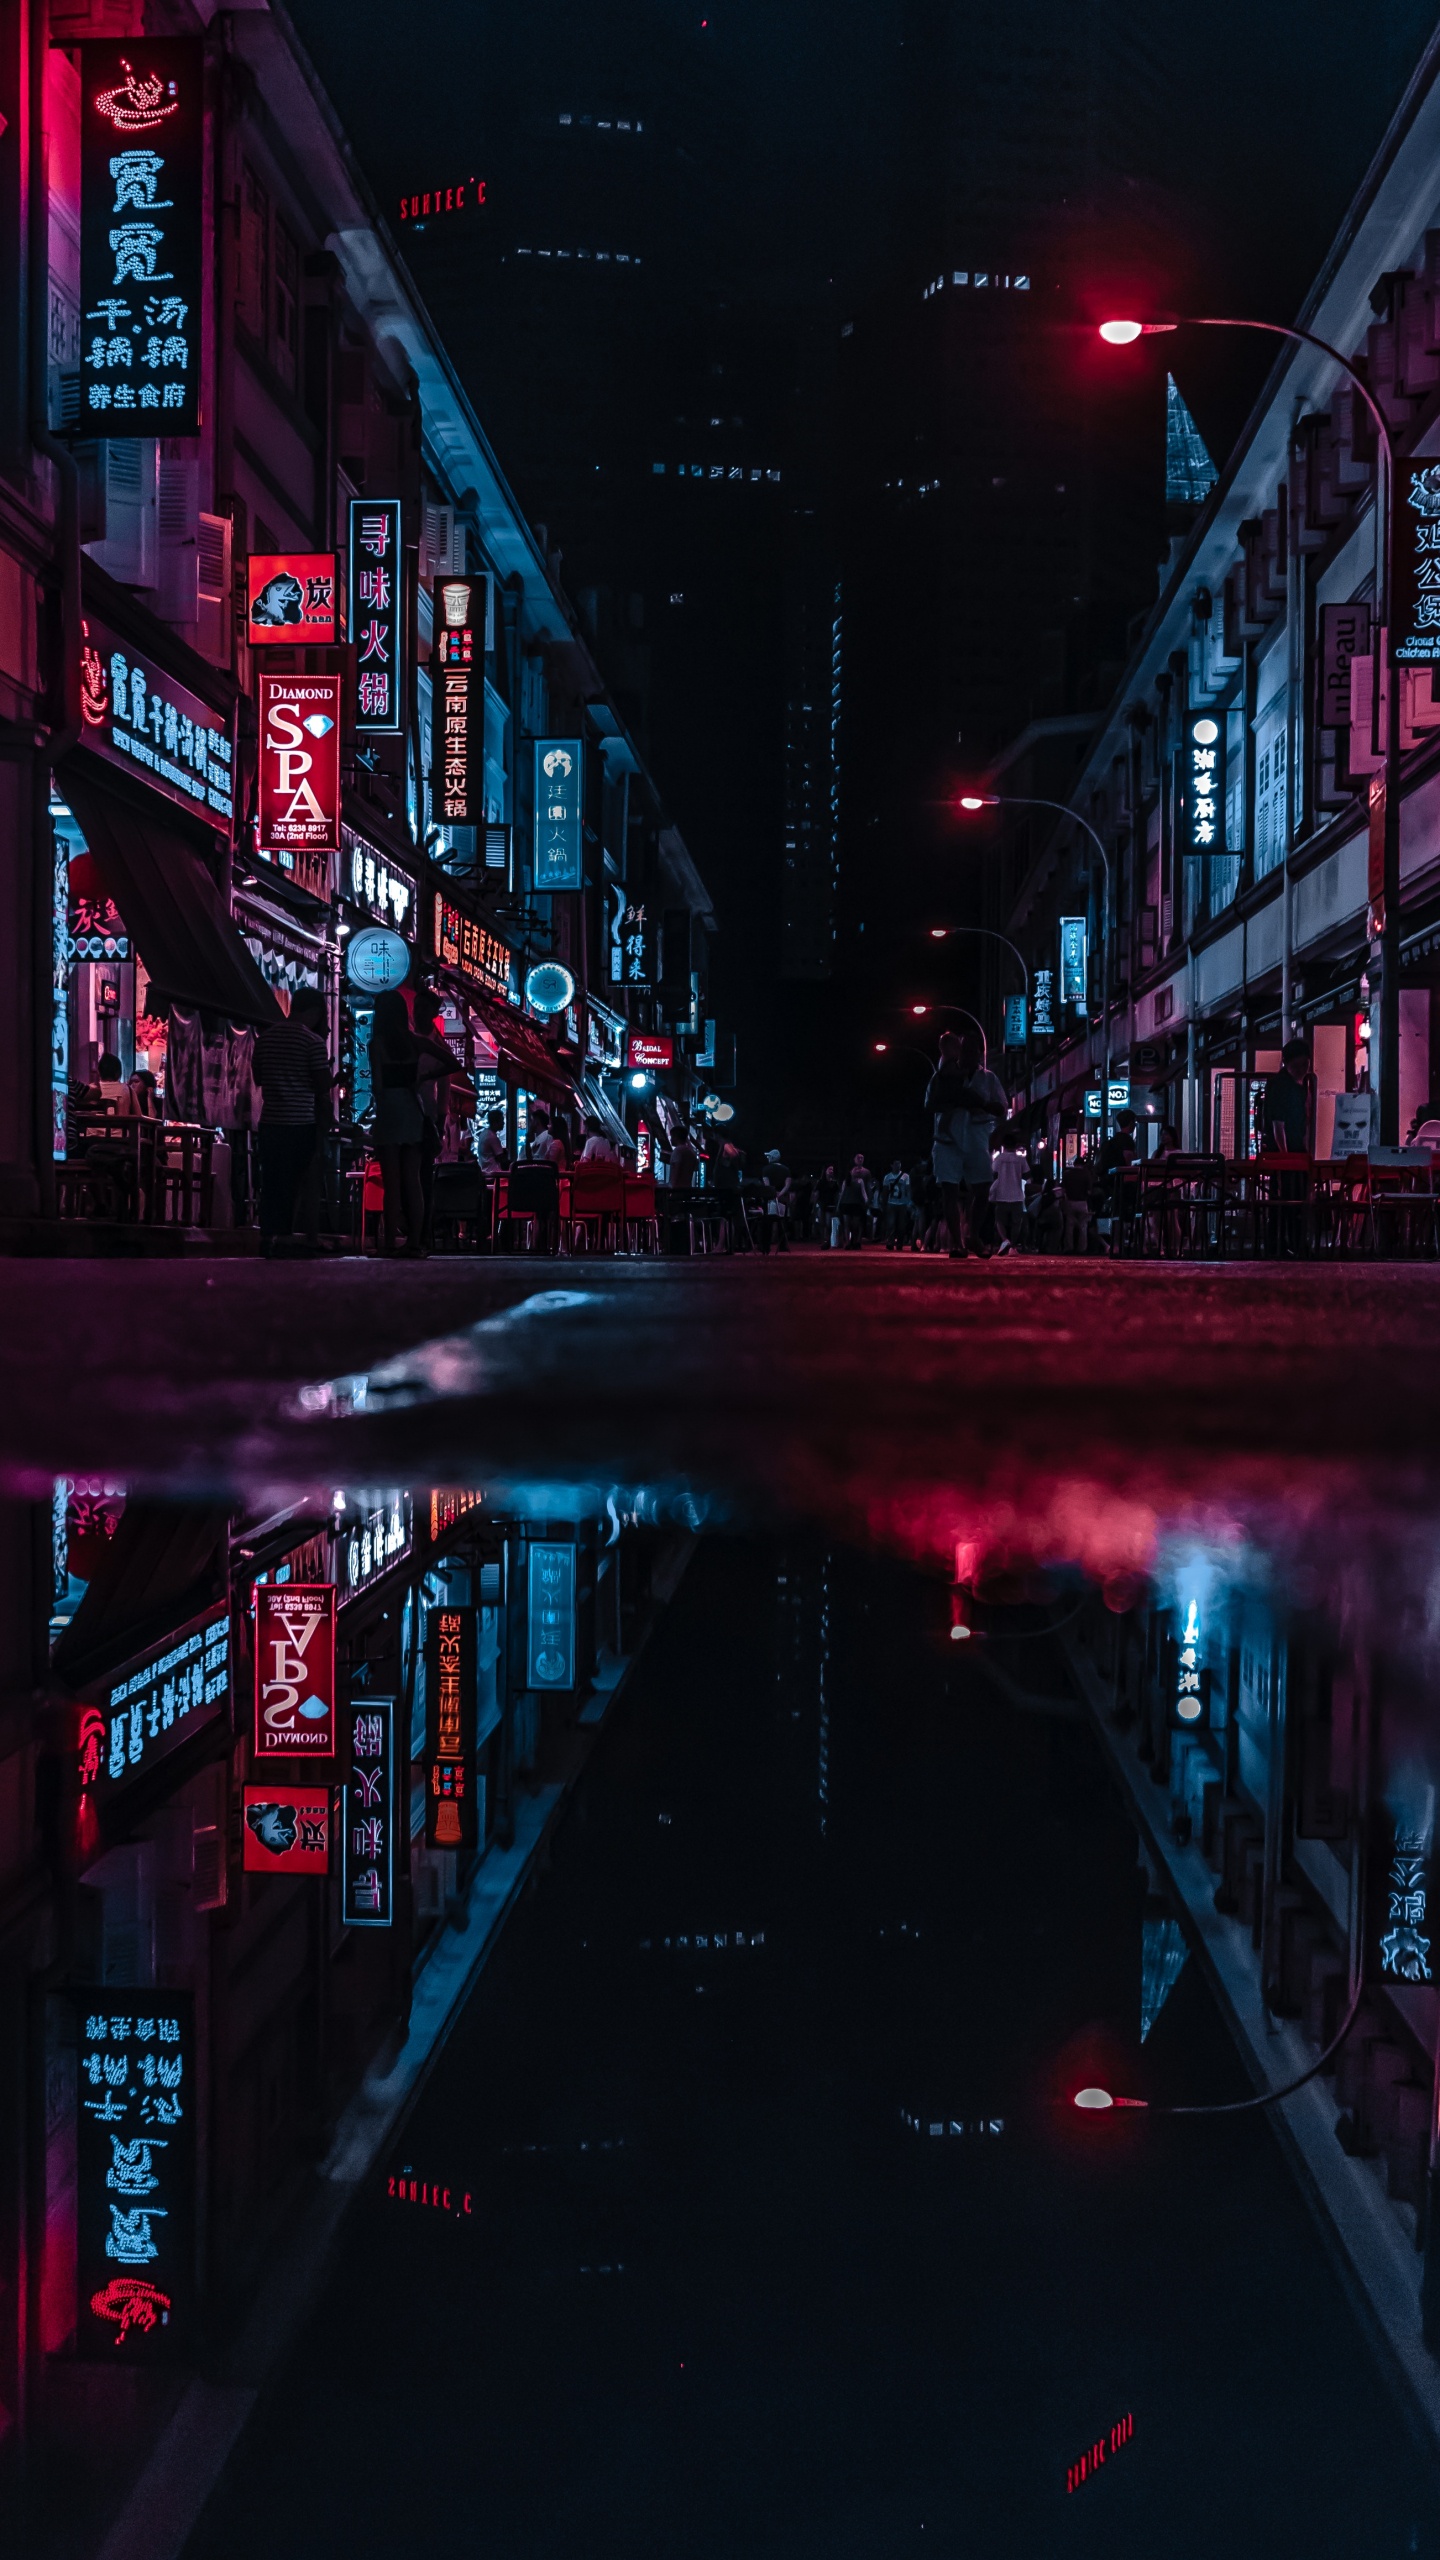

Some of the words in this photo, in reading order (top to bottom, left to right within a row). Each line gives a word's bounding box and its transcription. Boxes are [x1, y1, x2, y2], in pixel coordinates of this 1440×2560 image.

[88, 382, 187, 410] 养生食府
[305, 576, 333, 610] 炭
[358, 512, 391, 716] 寻味火锅
[1395, 646, 1432, 659] Chicken
[444, 675, 468, 817] 云南原生态火锅
[266, 703, 333, 822] SPA
[270, 832, 286, 840] 30A
[286, 831, 304, 841] (2nd
[305, 831, 329, 841] Floor)
[272, 824, 287, 832] Tel:
[288, 824, 307, 832] 6238
[308, 824, 327, 832] 8917
[634, 1052, 670, 1065] CONCEPT
[1108, 1090, 1128, 1099] NO.1
